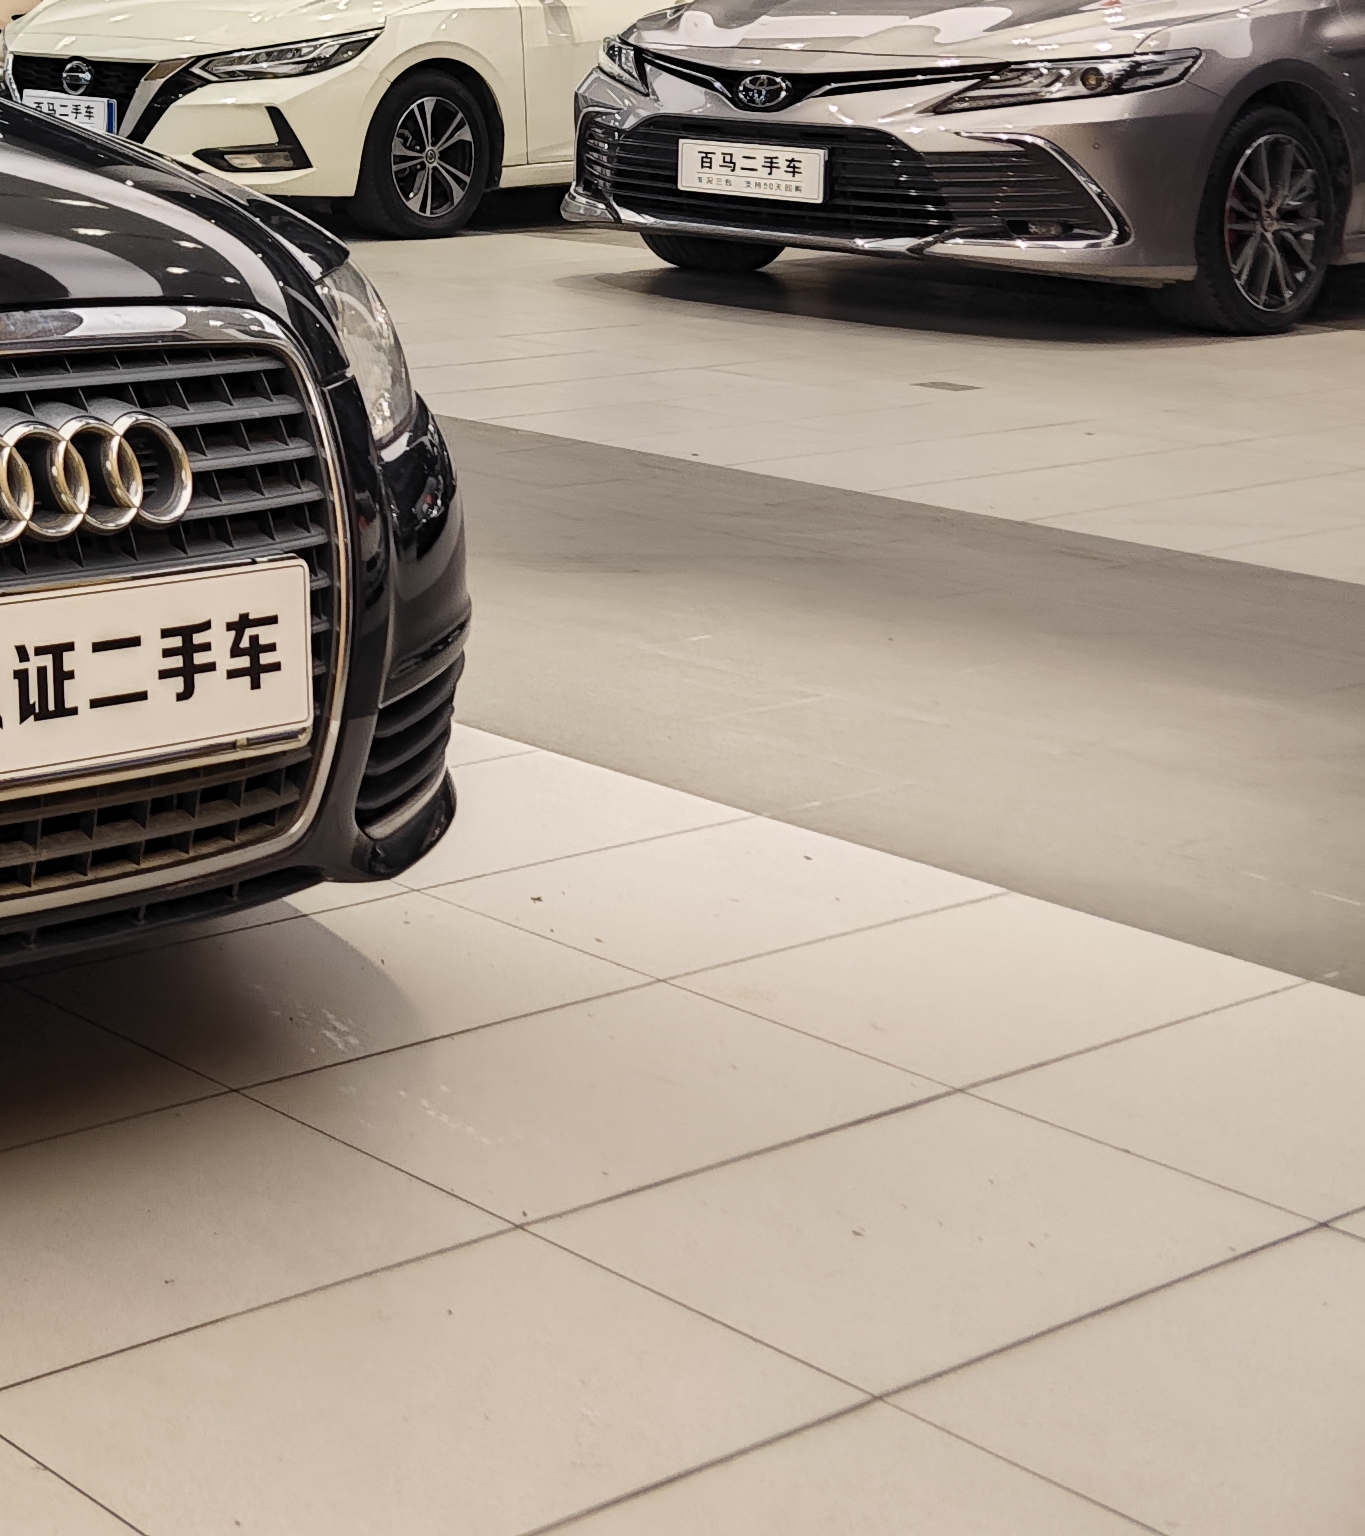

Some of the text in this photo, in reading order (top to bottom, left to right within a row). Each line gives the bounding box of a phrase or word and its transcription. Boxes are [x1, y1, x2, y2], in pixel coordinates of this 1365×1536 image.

[697, 150, 803, 178] 百马二手车
